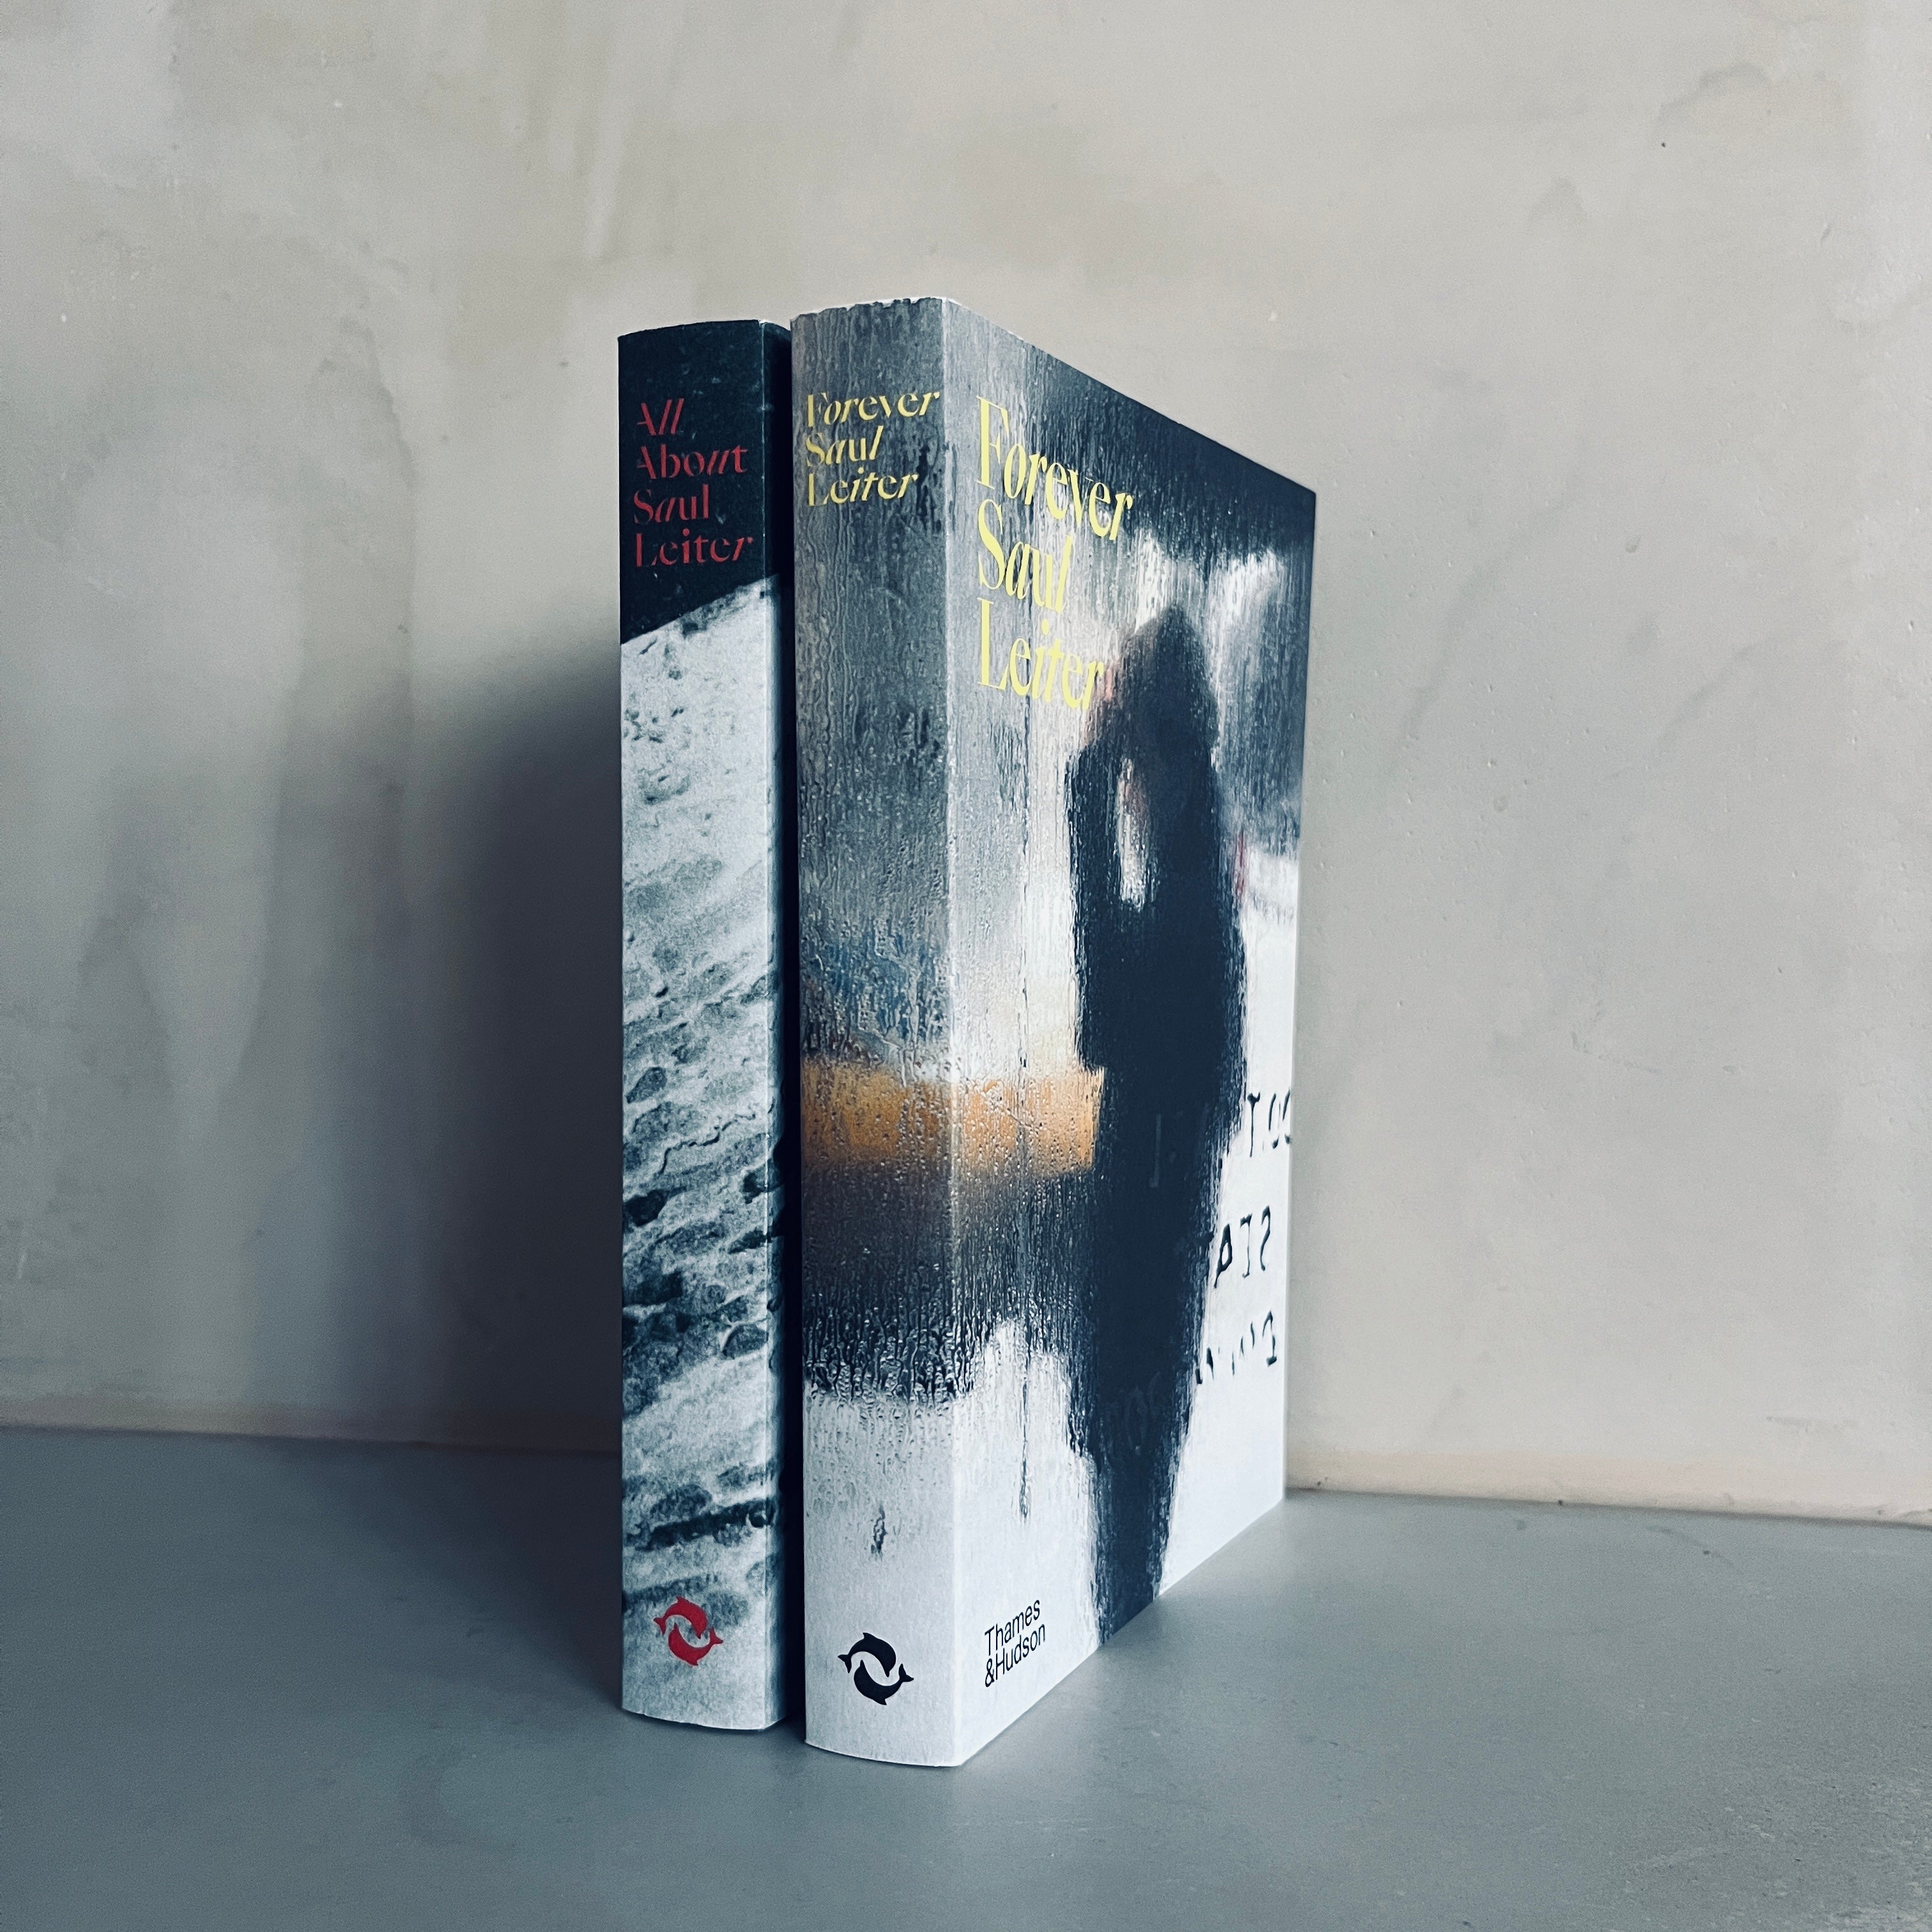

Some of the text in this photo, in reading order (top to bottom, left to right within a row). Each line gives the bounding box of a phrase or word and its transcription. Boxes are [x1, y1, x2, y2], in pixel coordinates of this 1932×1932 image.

[637, 398, 684, 436] All
[808, 391, 940, 427] Forever
[637, 444, 748, 479] About
[806, 425, 884, 467] Saul
[808, 466, 919, 507] Leiter
[976, 395, 1133, 540] Forever
[634, 484, 709, 524] Saul
[636, 528, 754, 567] Leiter
[977, 498, 1073, 613] Saul
[977, 597, 1104, 710] Leiter
[985, 1599, 1040, 1656] Thames
[985, 1623, 1046, 1688] &Hudson
